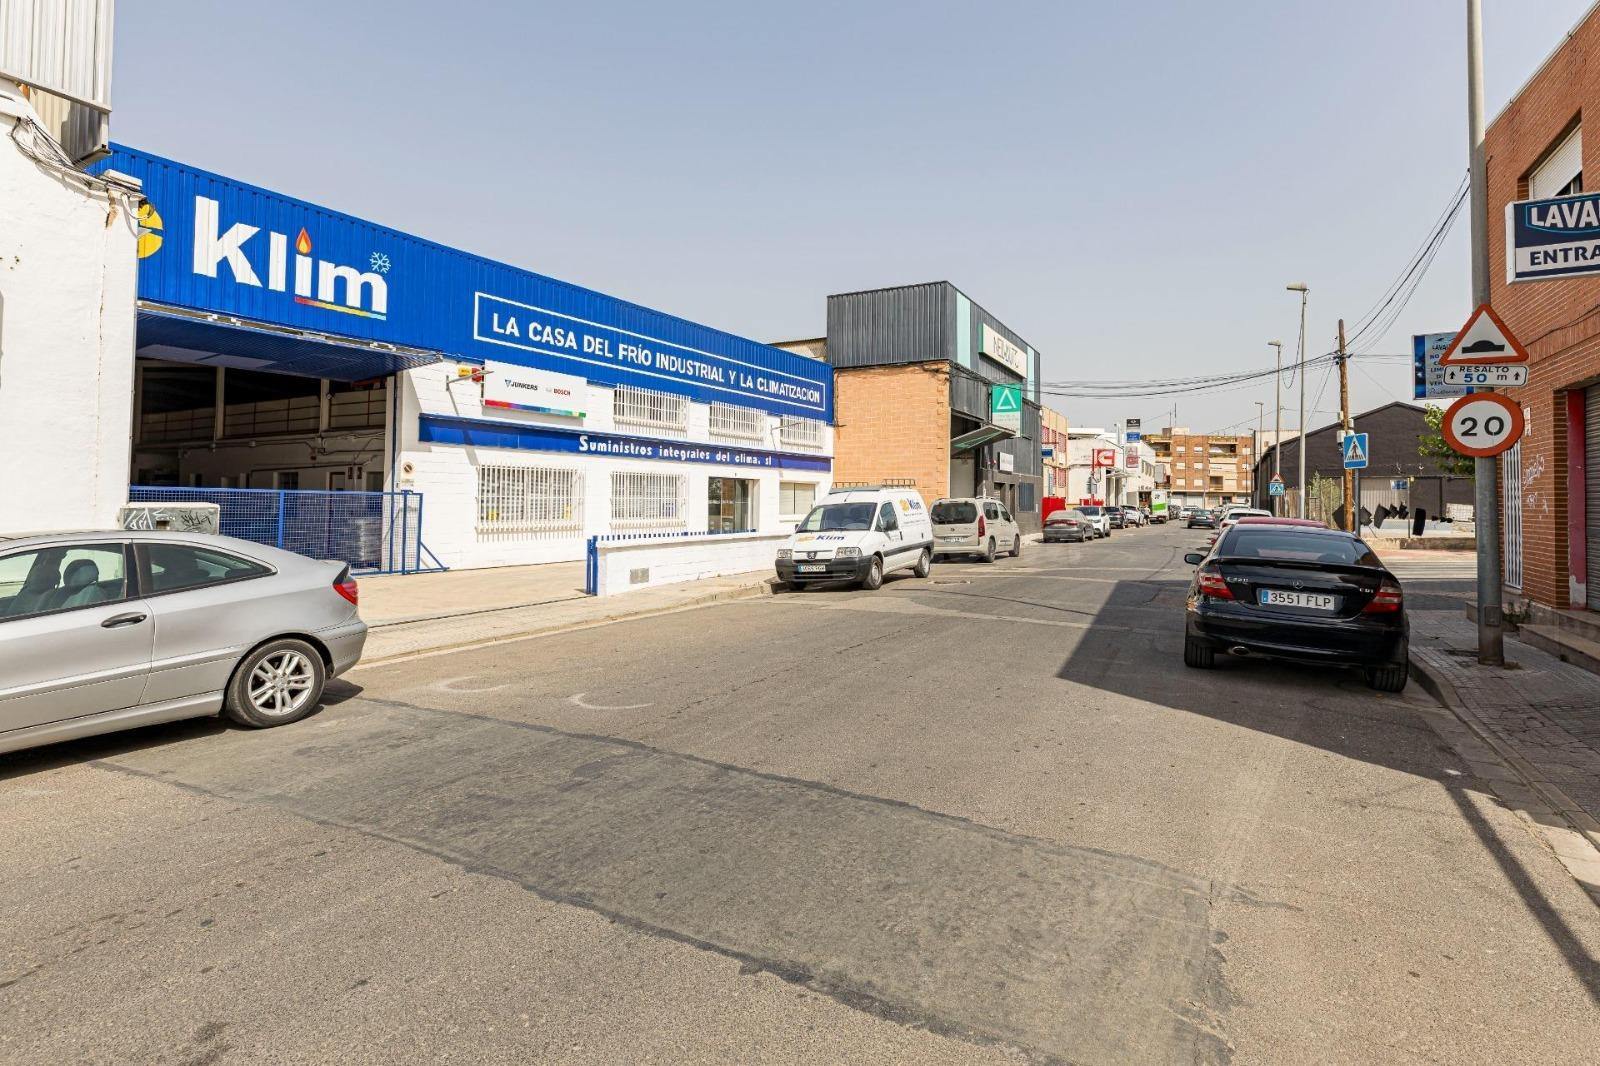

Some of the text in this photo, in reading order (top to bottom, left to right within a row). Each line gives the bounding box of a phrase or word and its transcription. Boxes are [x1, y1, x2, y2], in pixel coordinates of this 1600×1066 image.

[1531, 200, 1600, 228] LAVA
[493, 312, 820, 403] LA CASA DEL FRÍO INDUSTRIAL Y LA CLIMATIZACIÓN
[511, 381, 538, 391] JUNKERS
[1464, 373, 1488, 383] 50
[553, 388, 571, 396] BOSCH
[1460, 416, 1505, 437] 20
[578, 435, 652, 456] Suministros
[659, 445, 710, 461] integrales
[715, 451, 730, 462] del
[1271, 592, 1331, 608] 3551 FLP
